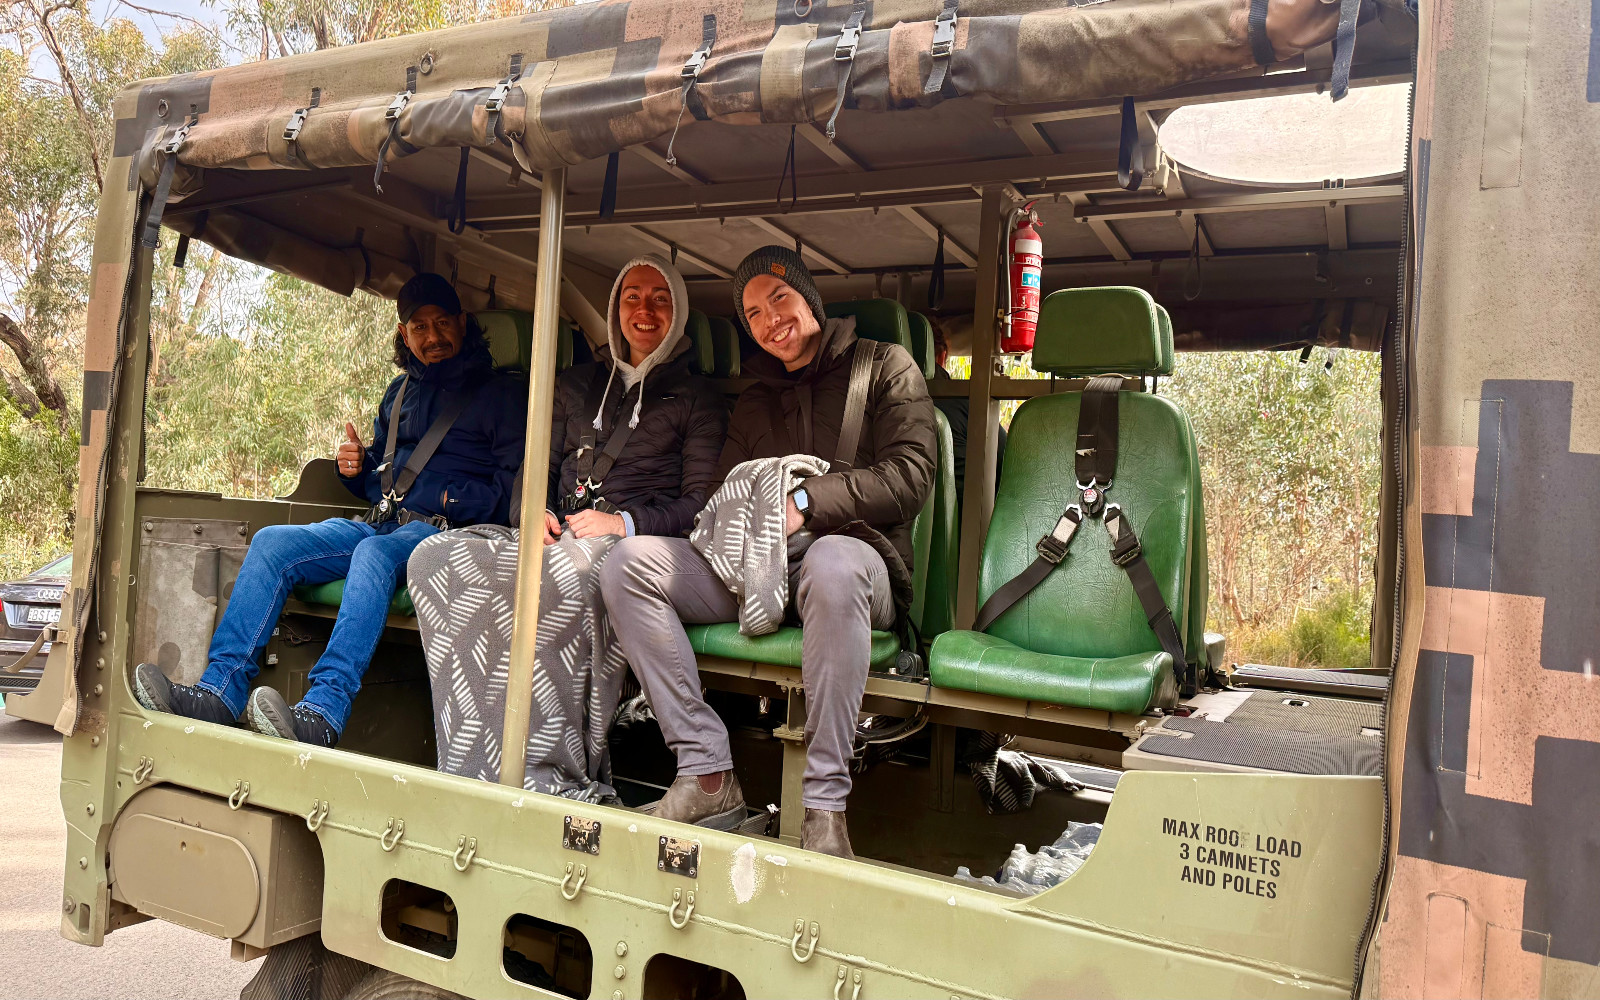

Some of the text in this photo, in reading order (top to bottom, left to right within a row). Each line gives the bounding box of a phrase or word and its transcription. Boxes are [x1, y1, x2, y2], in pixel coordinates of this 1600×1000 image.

[1162, 817, 1200, 840] MAX
[1255, 834, 1302, 858] LOAD
[1179, 842, 1281, 878] 3 CAMNETS
[1180, 865, 1277, 899] AND POLES
